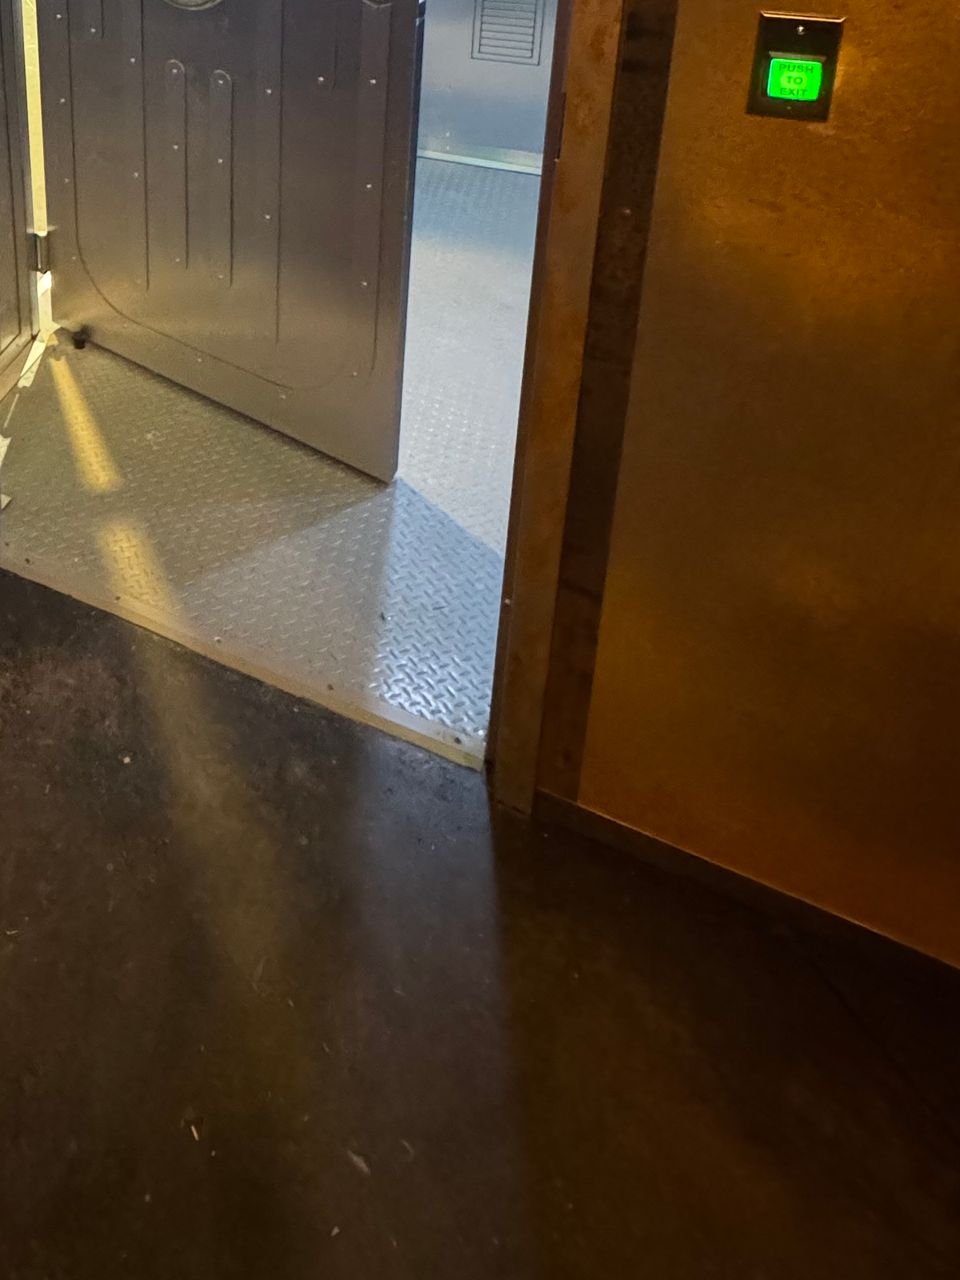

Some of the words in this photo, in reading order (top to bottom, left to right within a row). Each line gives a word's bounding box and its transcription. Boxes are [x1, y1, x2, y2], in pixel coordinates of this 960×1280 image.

[778, 63, 814, 73] PUSH
[787, 76, 803, 85] TO
[780, 87, 808, 96] EXIT
